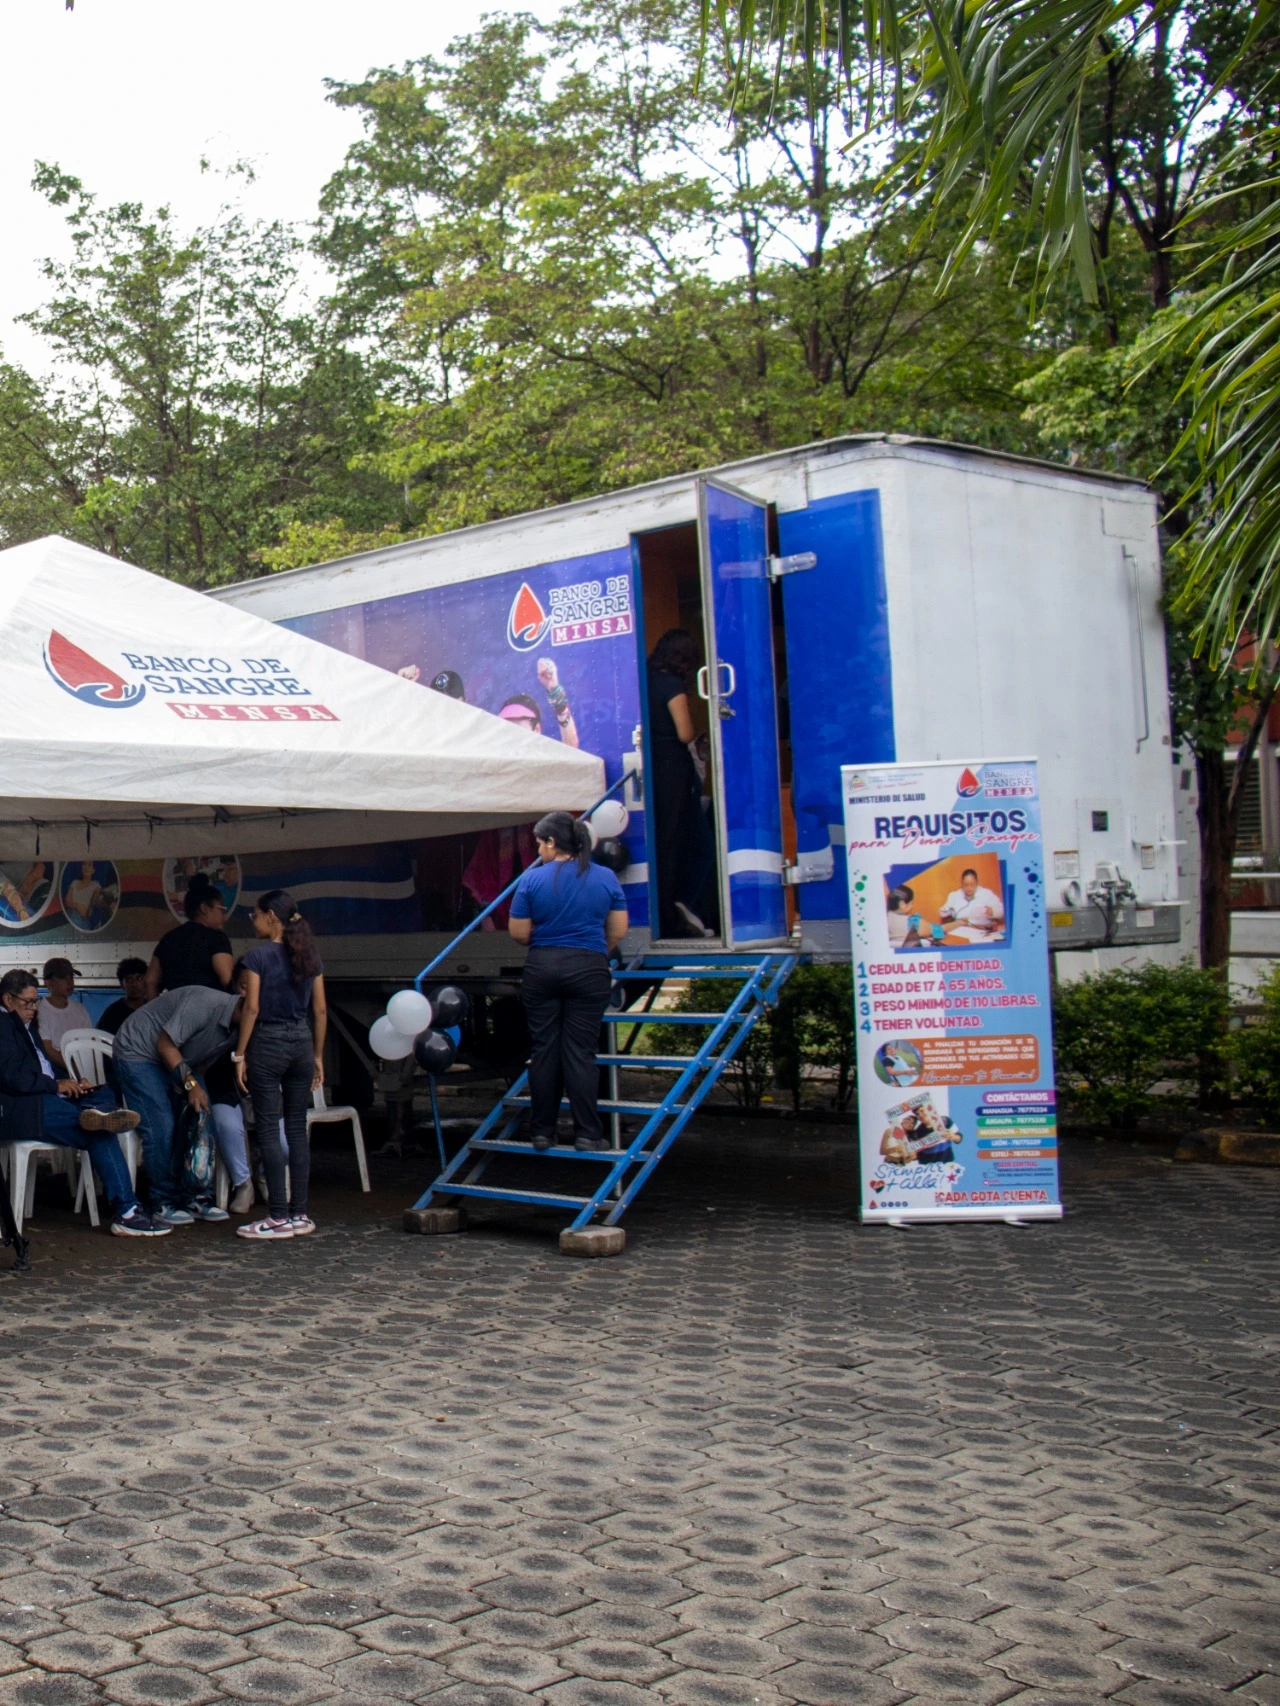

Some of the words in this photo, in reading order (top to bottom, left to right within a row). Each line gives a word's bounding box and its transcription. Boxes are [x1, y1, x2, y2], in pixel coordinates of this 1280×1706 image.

[550, 580, 600, 603] BANCO
[606, 575, 629, 592] DE
[552, 595, 629, 624] SANGRE
[555, 616, 629, 642] MINSA
[121, 652, 231, 674] BANCO
[242, 658, 290, 674] DE
[143, 675, 312, 696] SANGRE
[173, 702, 334, 721] MINSA
[984, 778, 1033, 788] SANGRE
[986, 787, 1033, 797] MINSA
[848, 795, 891, 805] MINISTERIO
[892, 794, 901, 803] DE
[902, 793, 926, 802] SALUD
[874, 809, 1027, 839] REQUISITOS
[848, 839, 891, 856] para
[901, 827, 956, 849] Donar
[966, 823, 1040, 852] Sangre
[857, 961, 868, 978] 1
[869, 961, 917, 976] CEDULA
[919, 960, 935, 974] DE
[936, 958, 1004, 973] IDENTIDAD.
[858, 983, 869, 997] 2
[871, 981, 904, 995] EDAD
[906, 980, 922, 993] DE
[923, 980, 934, 992] 17
[938, 980, 948, 991] A
[949, 979, 966, 990] 65
[968, 976, 1006, 990] AÑOS.
[859, 1001, 871, 1016] 3
[873, 999, 906, 1012] PESO
[954, 997, 971, 1009] DE
[972, 996, 989, 1008] 110
[990, 994, 1041, 1007] LIBRAS.
[860, 1019, 872, 1034] 4
[874, 1017, 913, 1031] TENER
[916, 1015, 983, 1029] VOLUNTAD.
[986, 1091, 1049, 1102] CONTÁCTANOS
[970, 1191, 1001, 1202] GOTA
[1003, 1190, 1048, 1201] CUENTA
